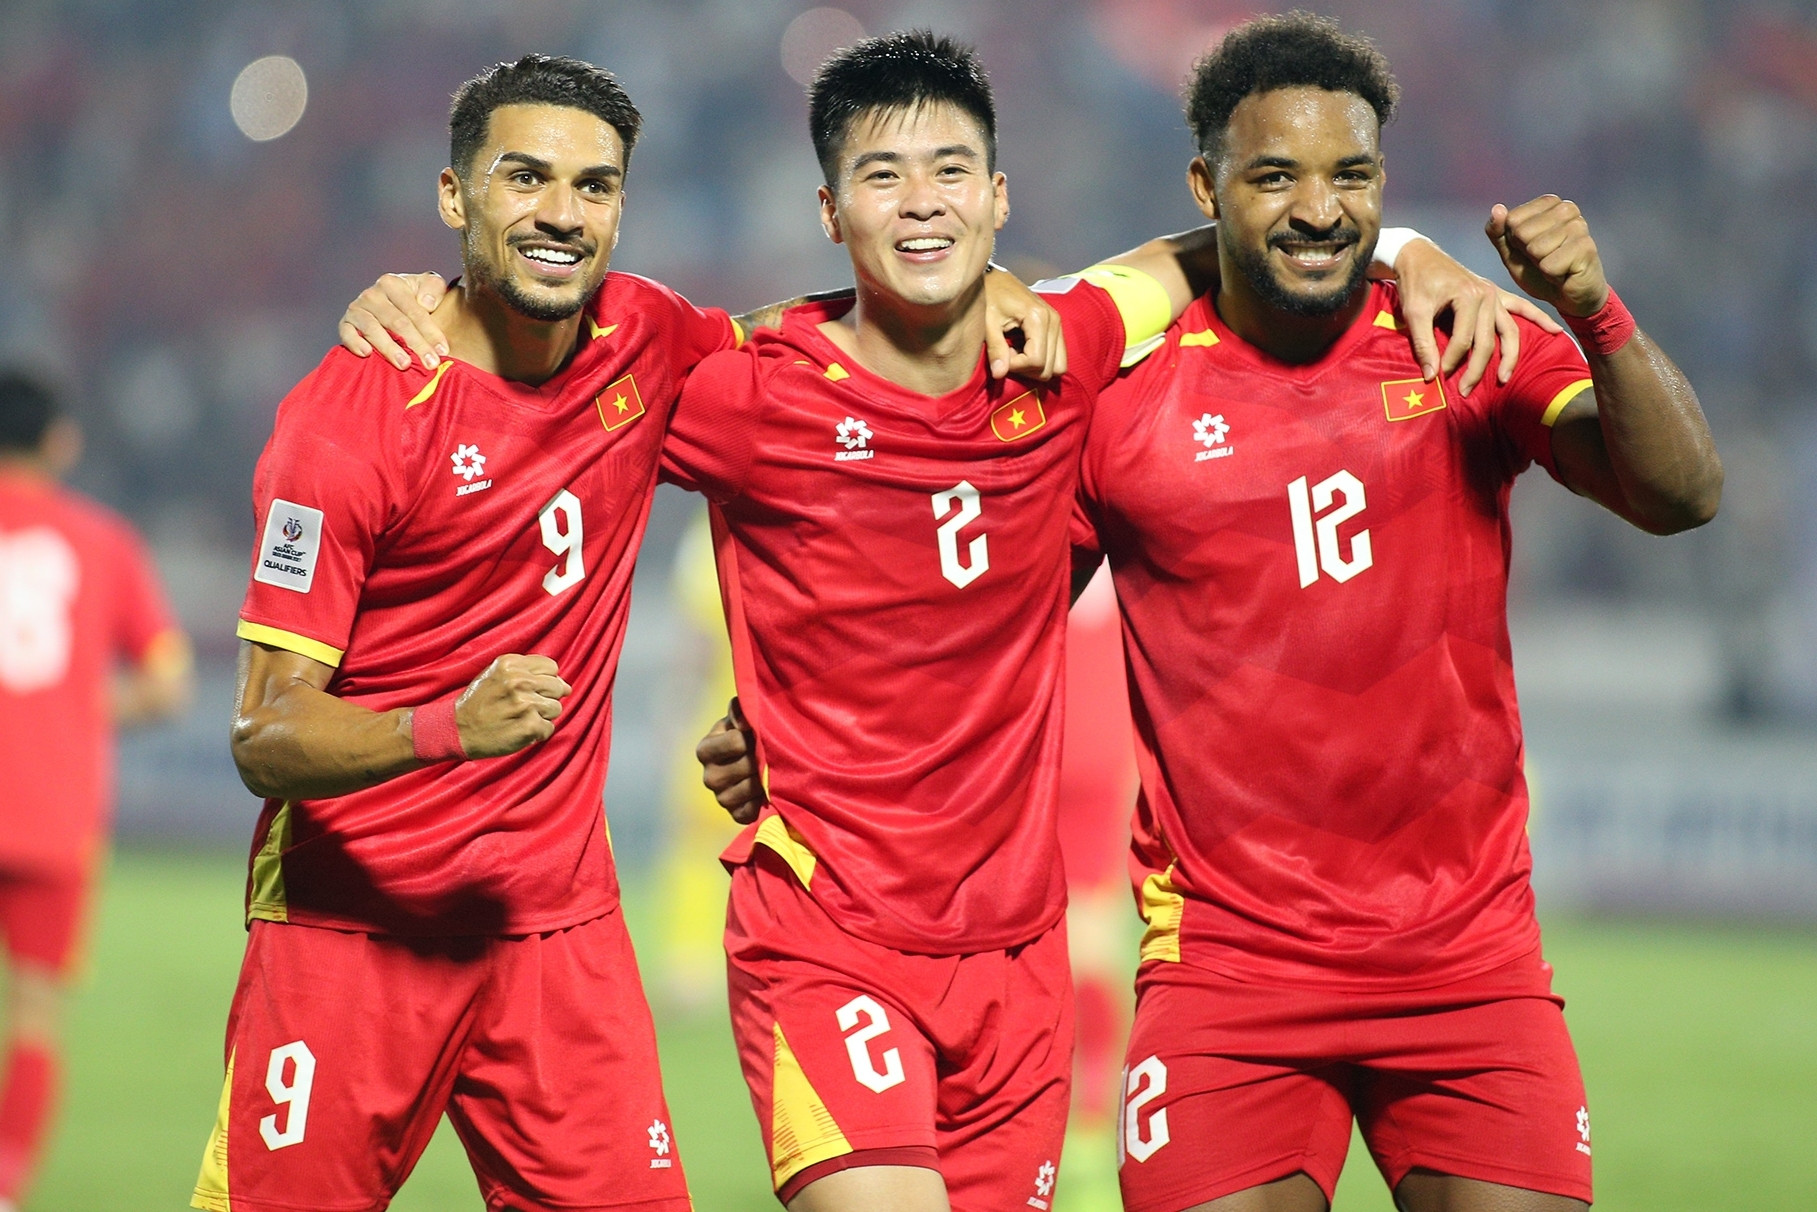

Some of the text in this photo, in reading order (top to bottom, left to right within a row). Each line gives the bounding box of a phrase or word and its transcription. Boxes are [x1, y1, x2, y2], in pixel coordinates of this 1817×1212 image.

[263, 559, 307, 577] QUALIFIERS
[273, 546, 291, 555] ASIAN
[283, 543, 295, 551] AFC
[538, 487, 586, 597] 9
[931, 480, 990, 590] 2
[1287, 469, 1374, 590] 12
[258, 1040, 316, 1151] 9
[835, 994, 905, 1094] 2
